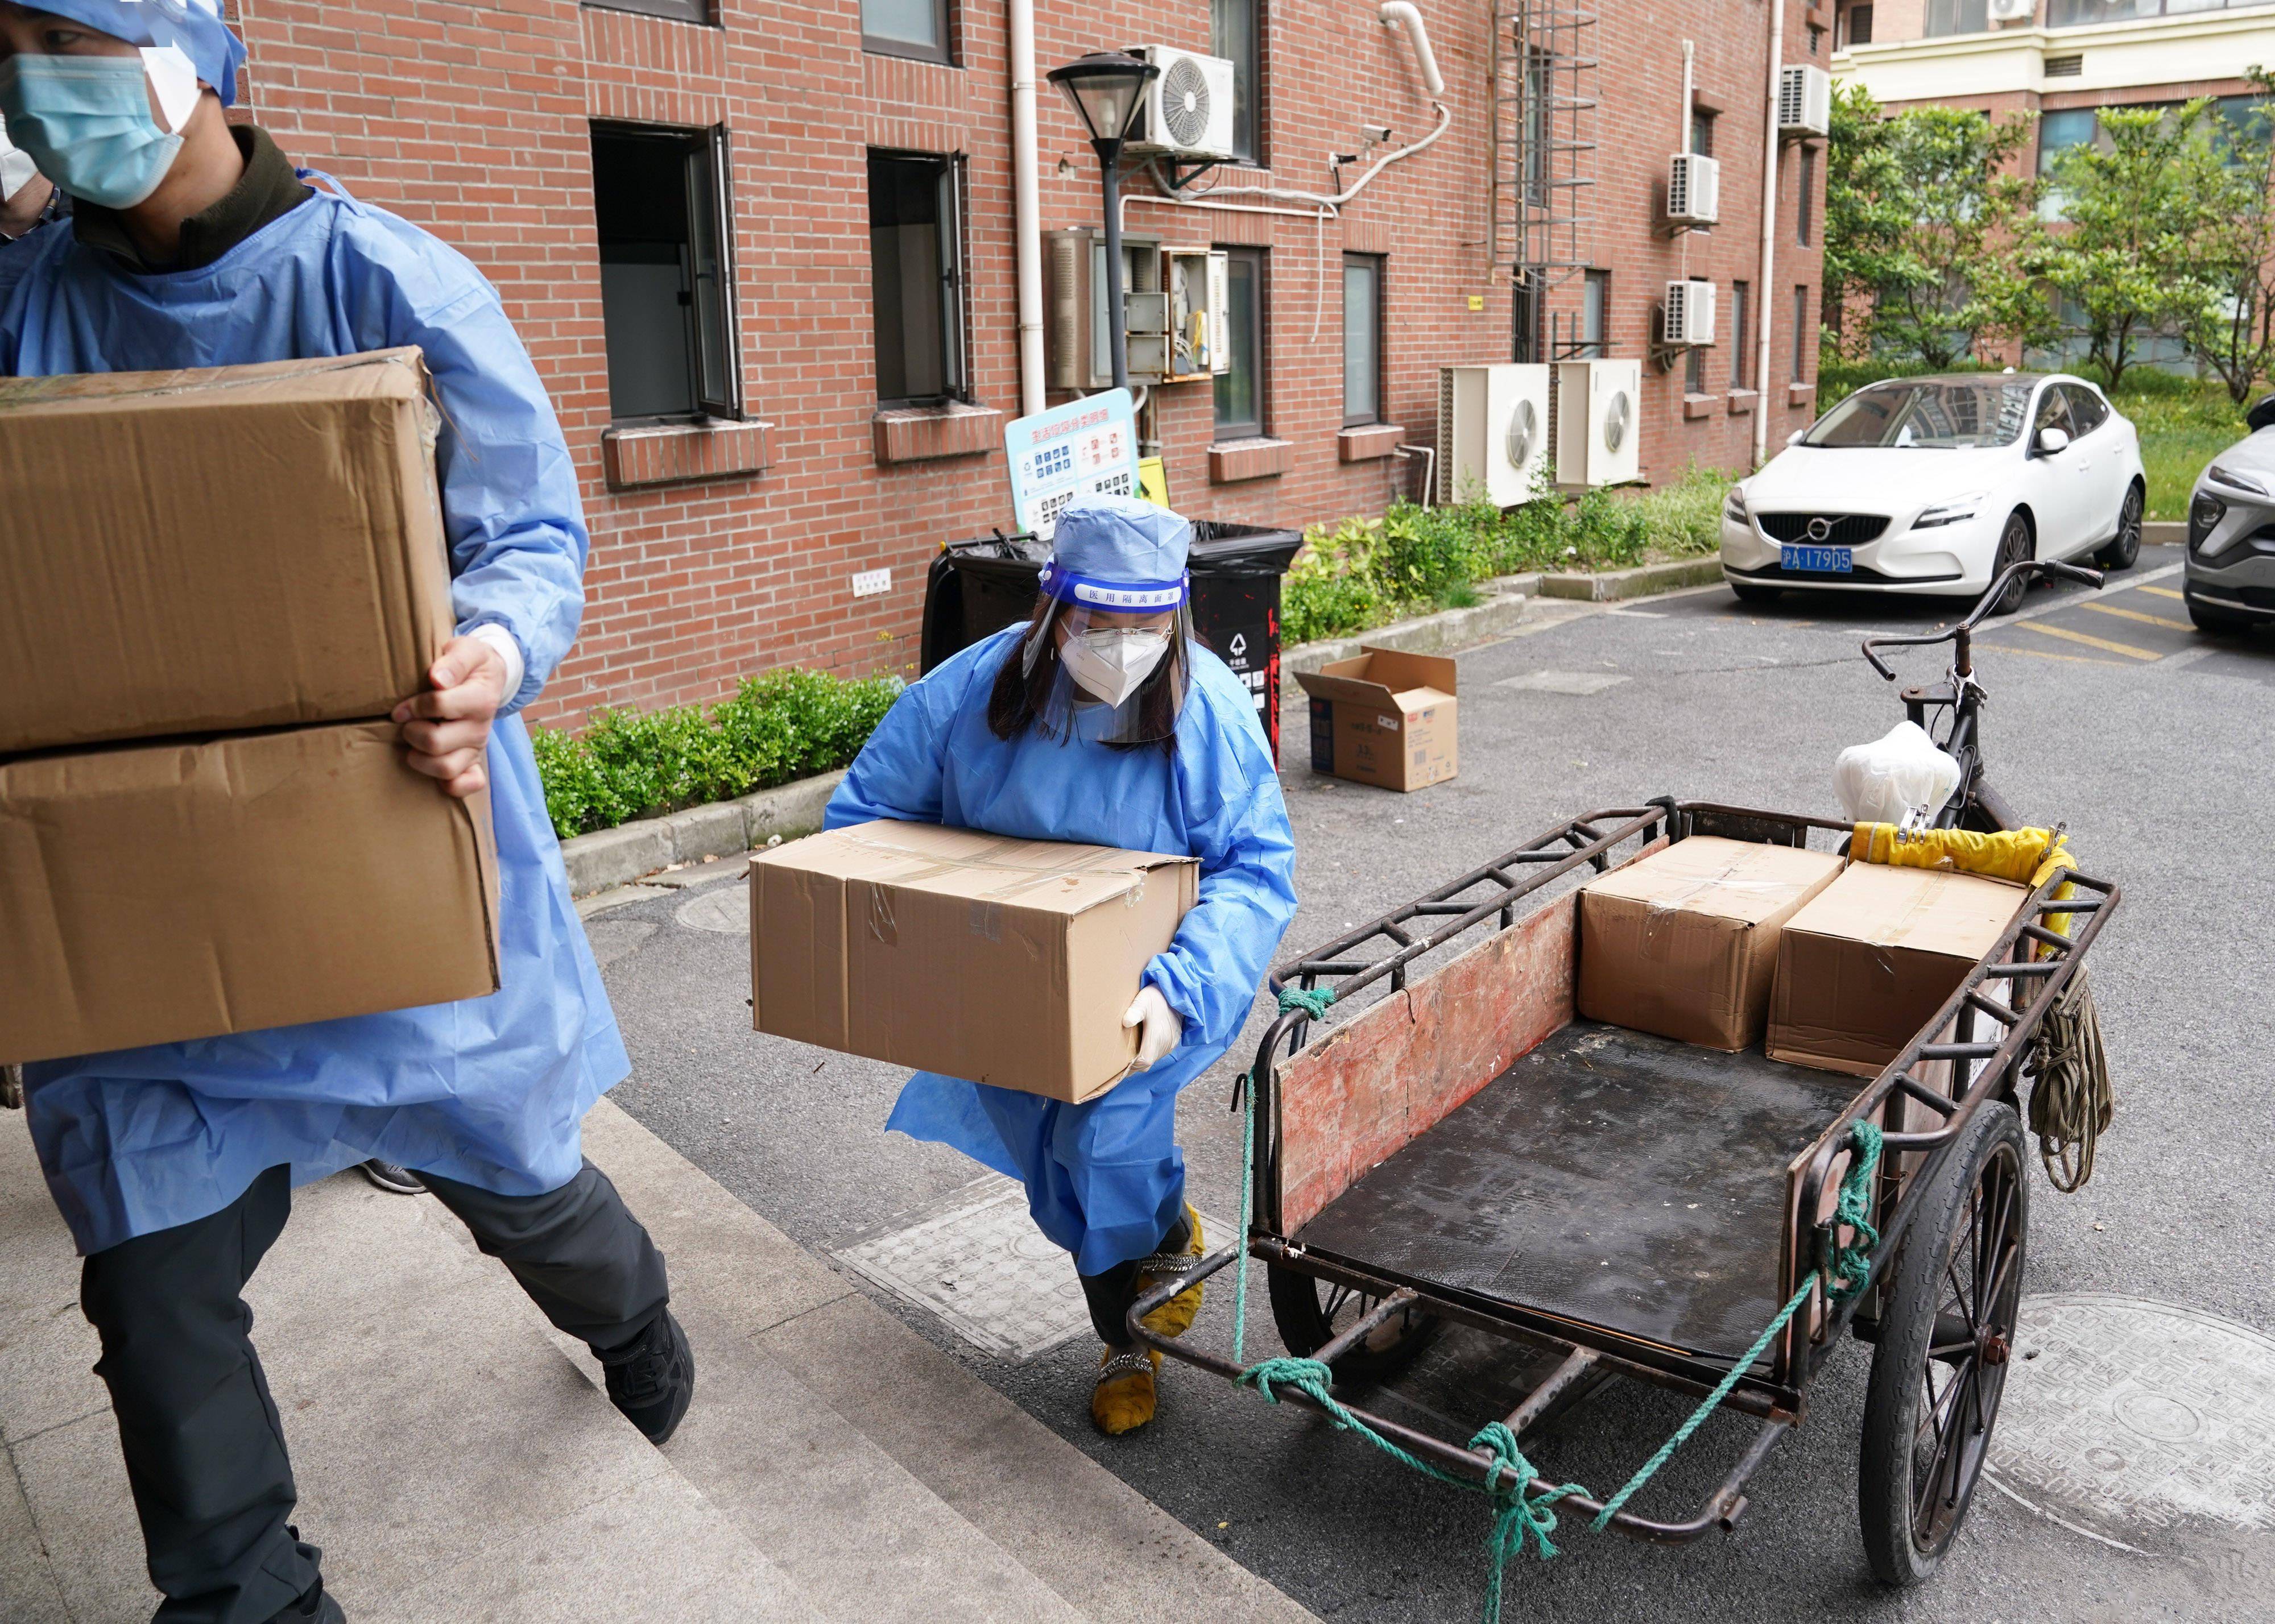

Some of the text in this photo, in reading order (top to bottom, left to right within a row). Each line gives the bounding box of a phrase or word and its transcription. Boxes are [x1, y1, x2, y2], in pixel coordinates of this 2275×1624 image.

[1089, 590, 1173, 603] 医用隔离面罩
